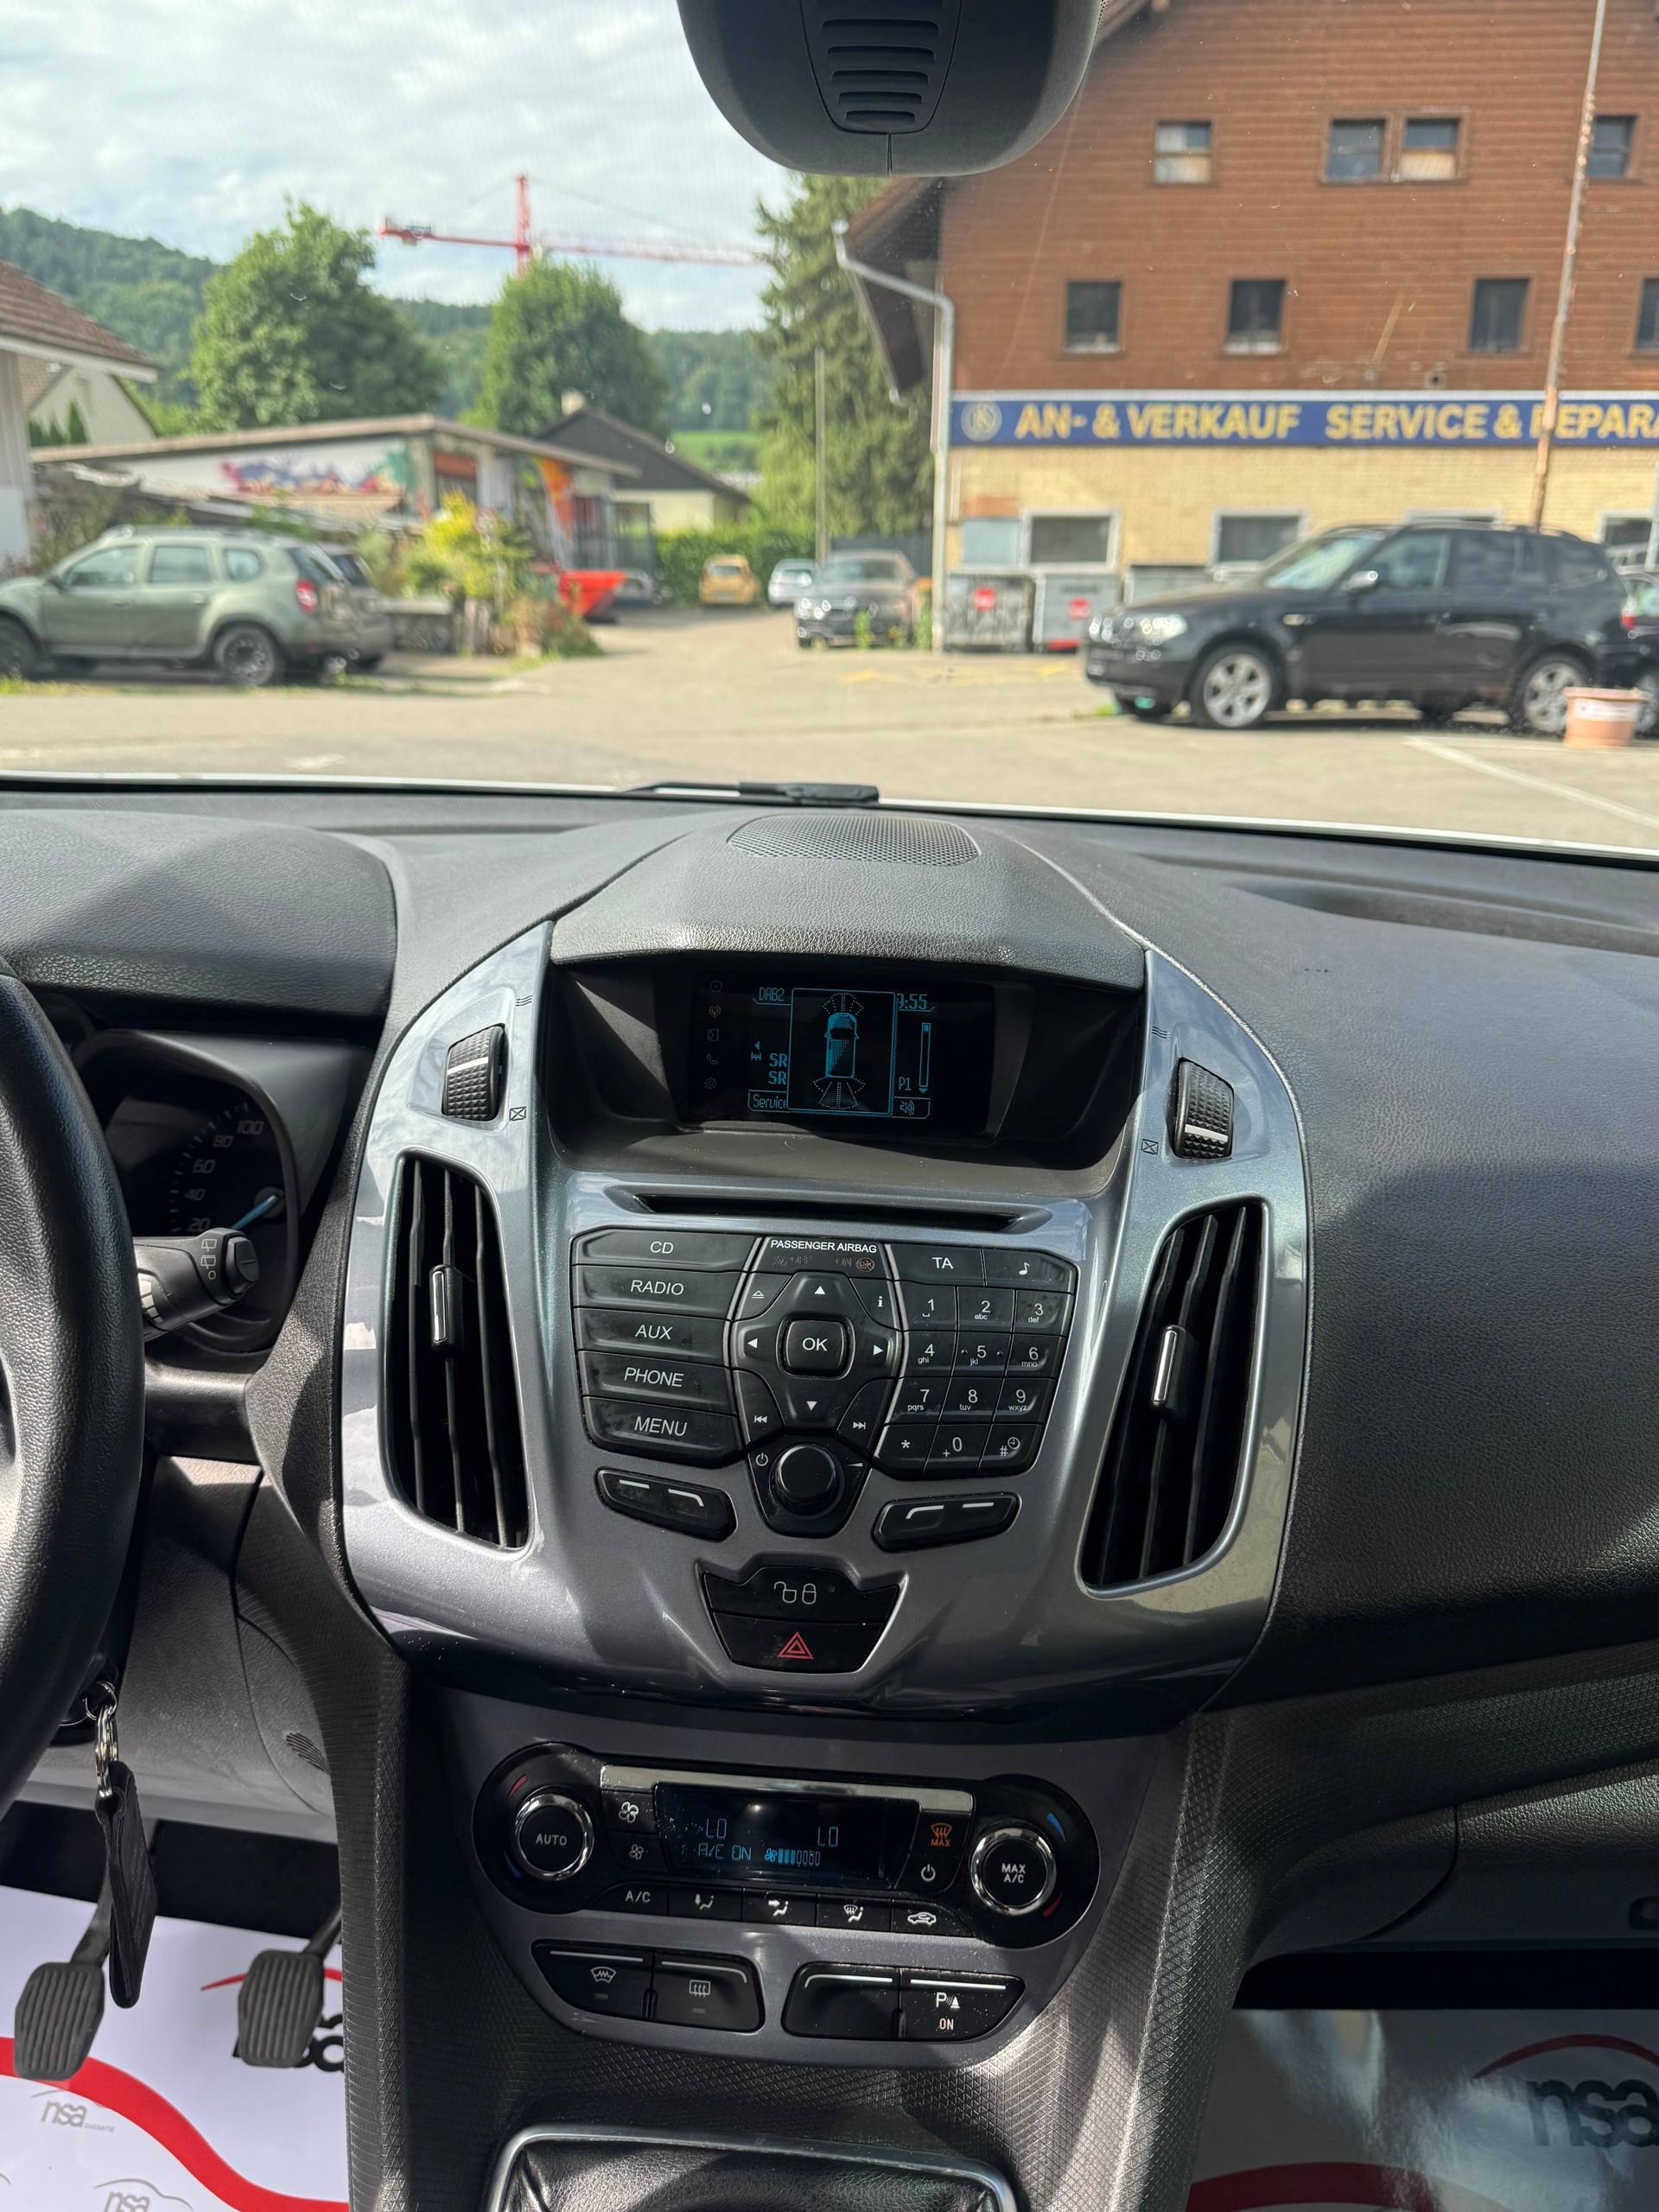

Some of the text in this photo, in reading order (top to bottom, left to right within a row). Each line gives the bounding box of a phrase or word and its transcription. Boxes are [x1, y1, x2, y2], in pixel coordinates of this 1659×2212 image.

[1014, 402, 1087, 439] AN-
[1091, 403, 1120, 439] &
[1127, 403, 1301, 439] VERKAUF
[1325, 403, 1489, 439] SERVICE
[1493, 404, 1522, 439] &
[1529, 404, 1659, 439] EPAR
[759, 987, 785, 1002] DAB2
[769, 1052, 787, 1067] SR
[768, 1070, 787, 1085] SR
[238, 1121, 264, 1135] 100
[213, 1135, 233, 1147] 80
[193, 1159, 215, 1174] 60
[185, 1188, 206, 1201] 40
[188, 1217, 211, 1232] 20
[650, 1241, 674, 1254] CD
[771, 1240, 877, 1253] PASSENGER AIRBAG
[931, 1256, 954, 1270] TA
[630, 1279, 684, 1296] RADIO
[927, 1298, 936, 1312] 1
[981, 1300, 991, 1313] 2
[1033, 1302, 1044, 1316] 3
[1027, 1316, 1039, 1325] def
[634, 1324, 673, 1340] AUX
[802, 1337, 829, 1352] OK
[925, 1344, 935, 1357] 4
[976, 1344, 987, 1359] 5
[1028, 1346, 1039, 1362] 6
[918, 1357, 930, 1366] ghi
[969, 1357, 979, 1367] jkl
[624, 1366, 684, 1388] PHONE
[919, 1389, 930, 1403] 7
[968, 1389, 978, 1403] 8
[1015, 1389, 1027, 1404] 9
[907, 1403, 925, 1412] pqrs
[959, 1402, 971, 1411] tuv
[634, 1415, 688, 1437] MENU
[535, 1832, 568, 1847] AUTO
[931, 1838, 951, 1847] MAX
[697, 1842, 753, 1861] A/C ON
[1001, 1864, 1026, 1874] MAX
[1003, 1872, 1025, 1884] A/C
[625, 1890, 652, 1904] A/C
[938, 2018, 955, 2031] ON
[41, 2101, 87, 2127] nsa
